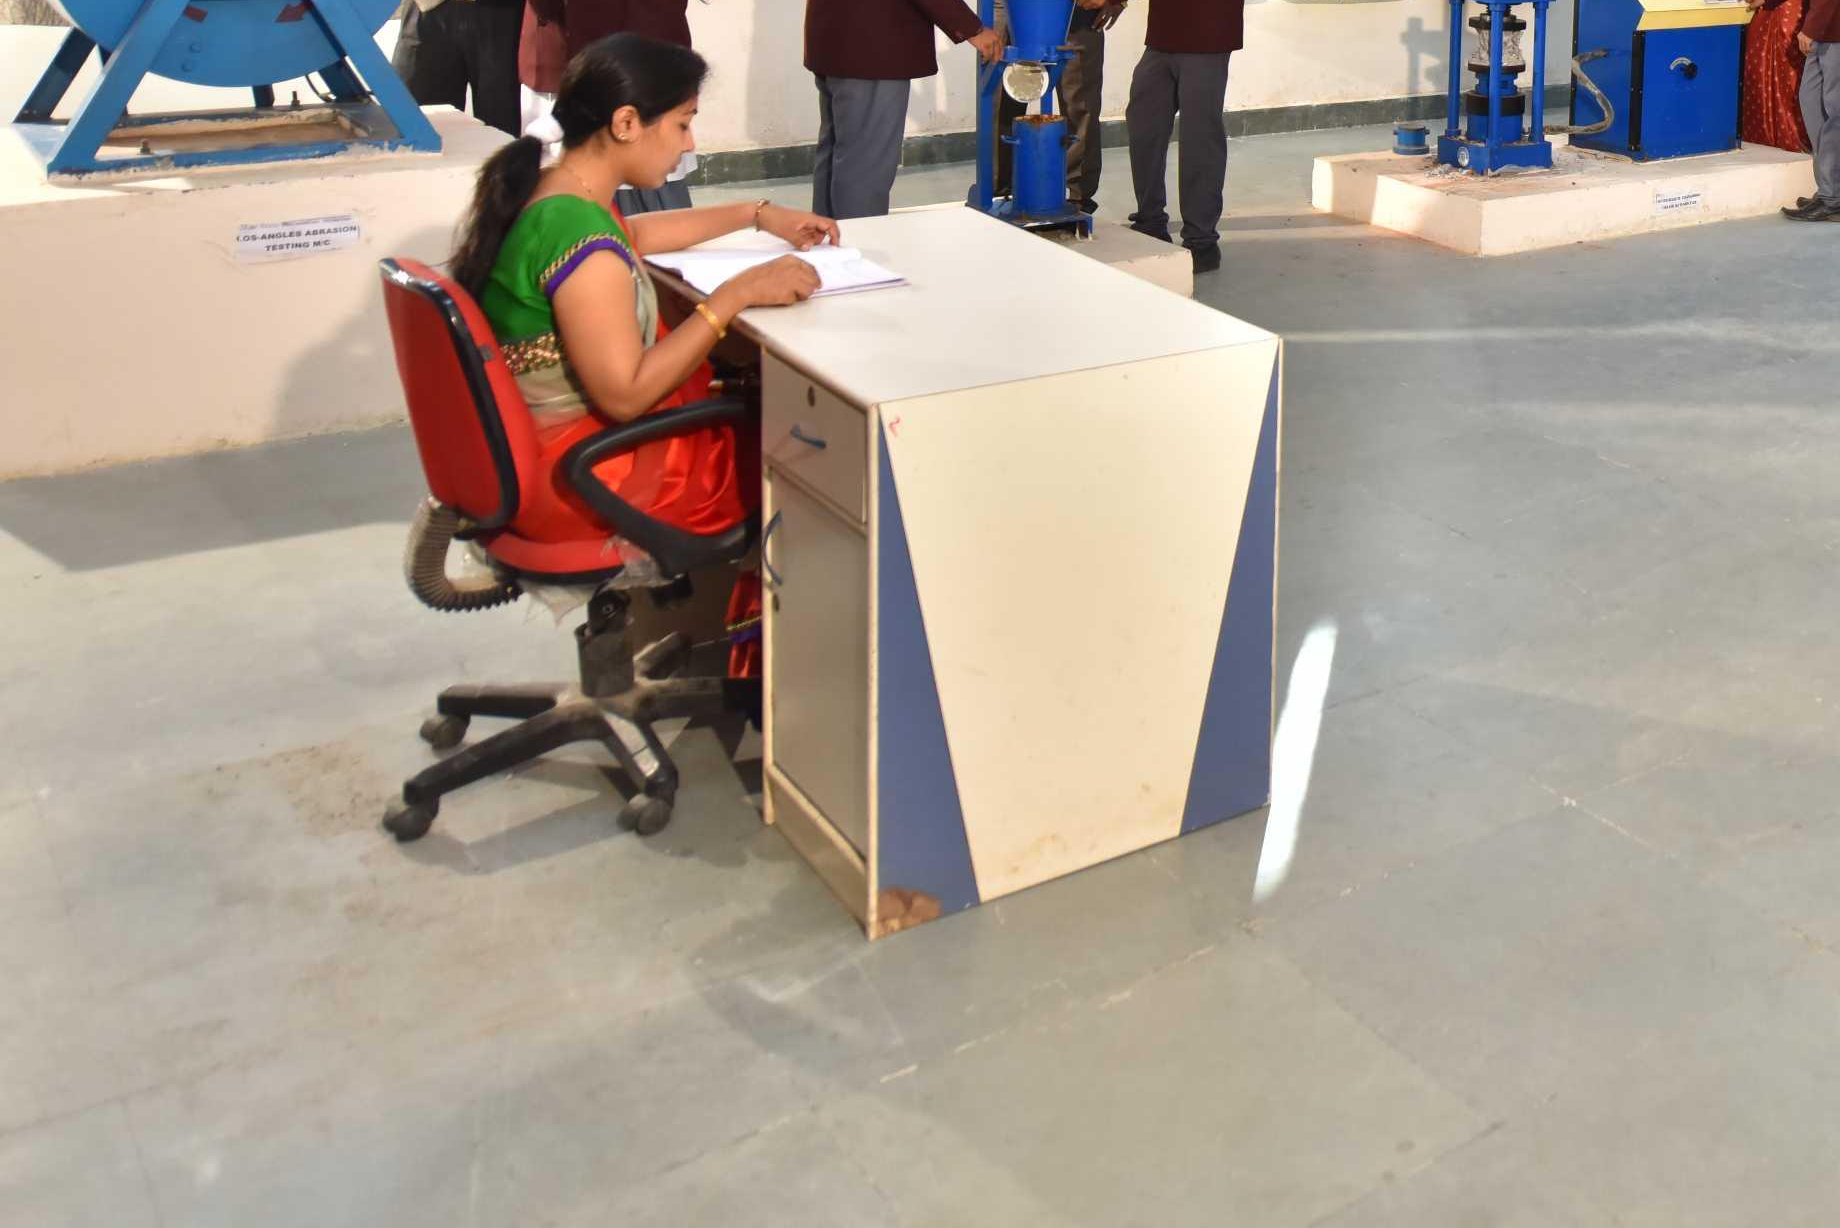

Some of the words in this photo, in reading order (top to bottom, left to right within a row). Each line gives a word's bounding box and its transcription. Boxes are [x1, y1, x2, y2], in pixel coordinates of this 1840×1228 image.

[236, 230, 302, 242] LOS-ANGLES
[305, 226, 356, 236] ABRASION
[265, 242, 310, 252] TESTING
